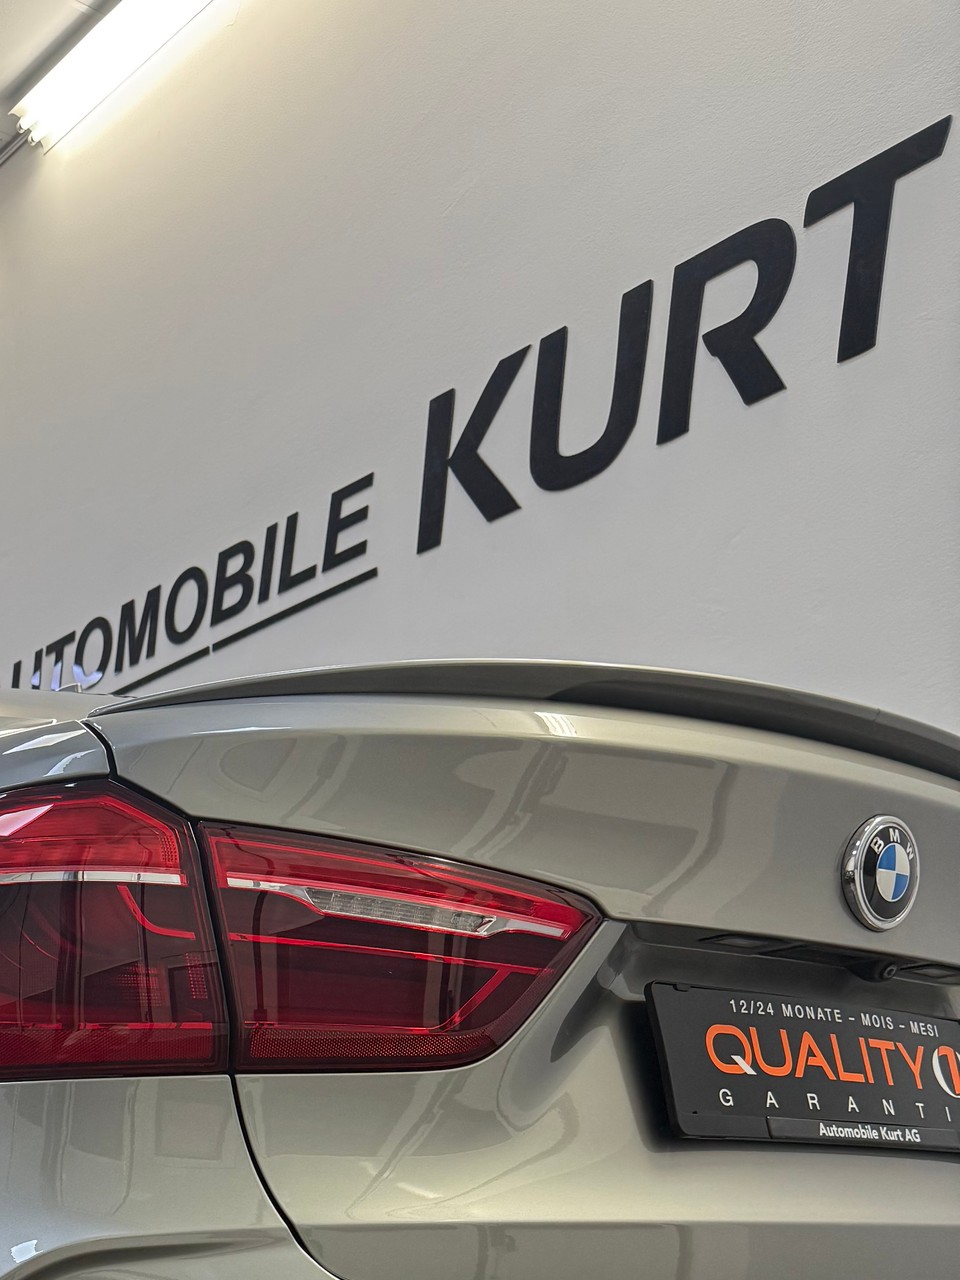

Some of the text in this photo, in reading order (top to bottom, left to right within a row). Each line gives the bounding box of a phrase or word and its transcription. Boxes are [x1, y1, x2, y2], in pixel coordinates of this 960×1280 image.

[416, 114, 952, 555] KURT
[870, 828, 914, 860] BMW
[729, 999, 774, 1015] 12/24
[781, 1003, 843, 1023] MONATE
[861, 1012, 894, 1030] MOIS
[910, 1020, 939, 1038] MESI
[820, 1122, 921, 1143] Automobile Kurt AG
